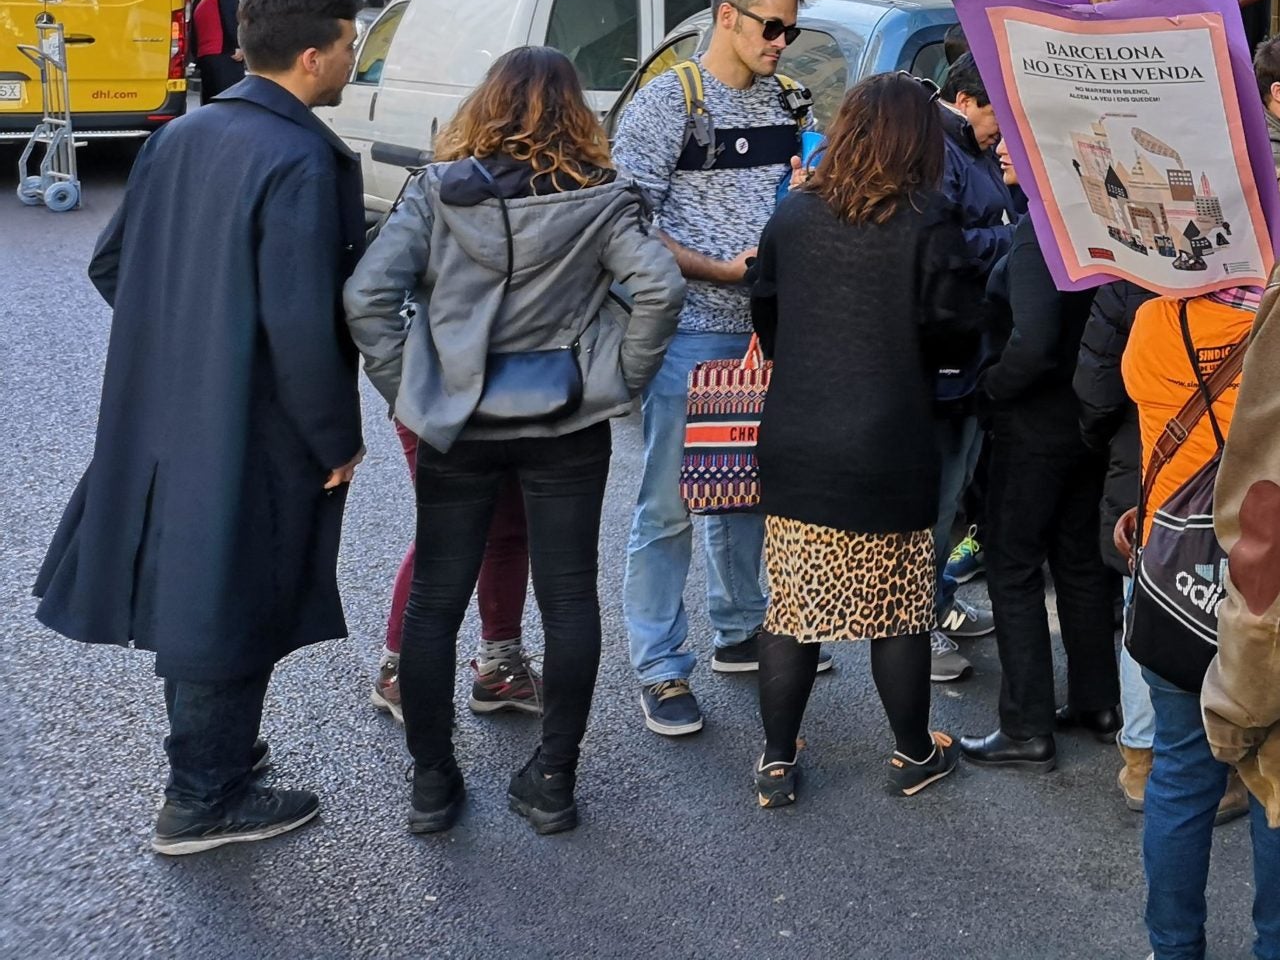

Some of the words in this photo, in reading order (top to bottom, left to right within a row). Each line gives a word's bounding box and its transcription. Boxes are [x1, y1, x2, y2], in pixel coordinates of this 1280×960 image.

[1045, 41, 1164, 60] BARCELONA
[1023, 58, 1050, 74] NO
[1054, 63, 1096, 80] ESTÀ
[1101, 68, 1128, 81] EN
[1132, 65, 1204, 81] VENDA
[92, 90, 138, 100] dhl.com
[1176, 571, 1222, 618] adi
